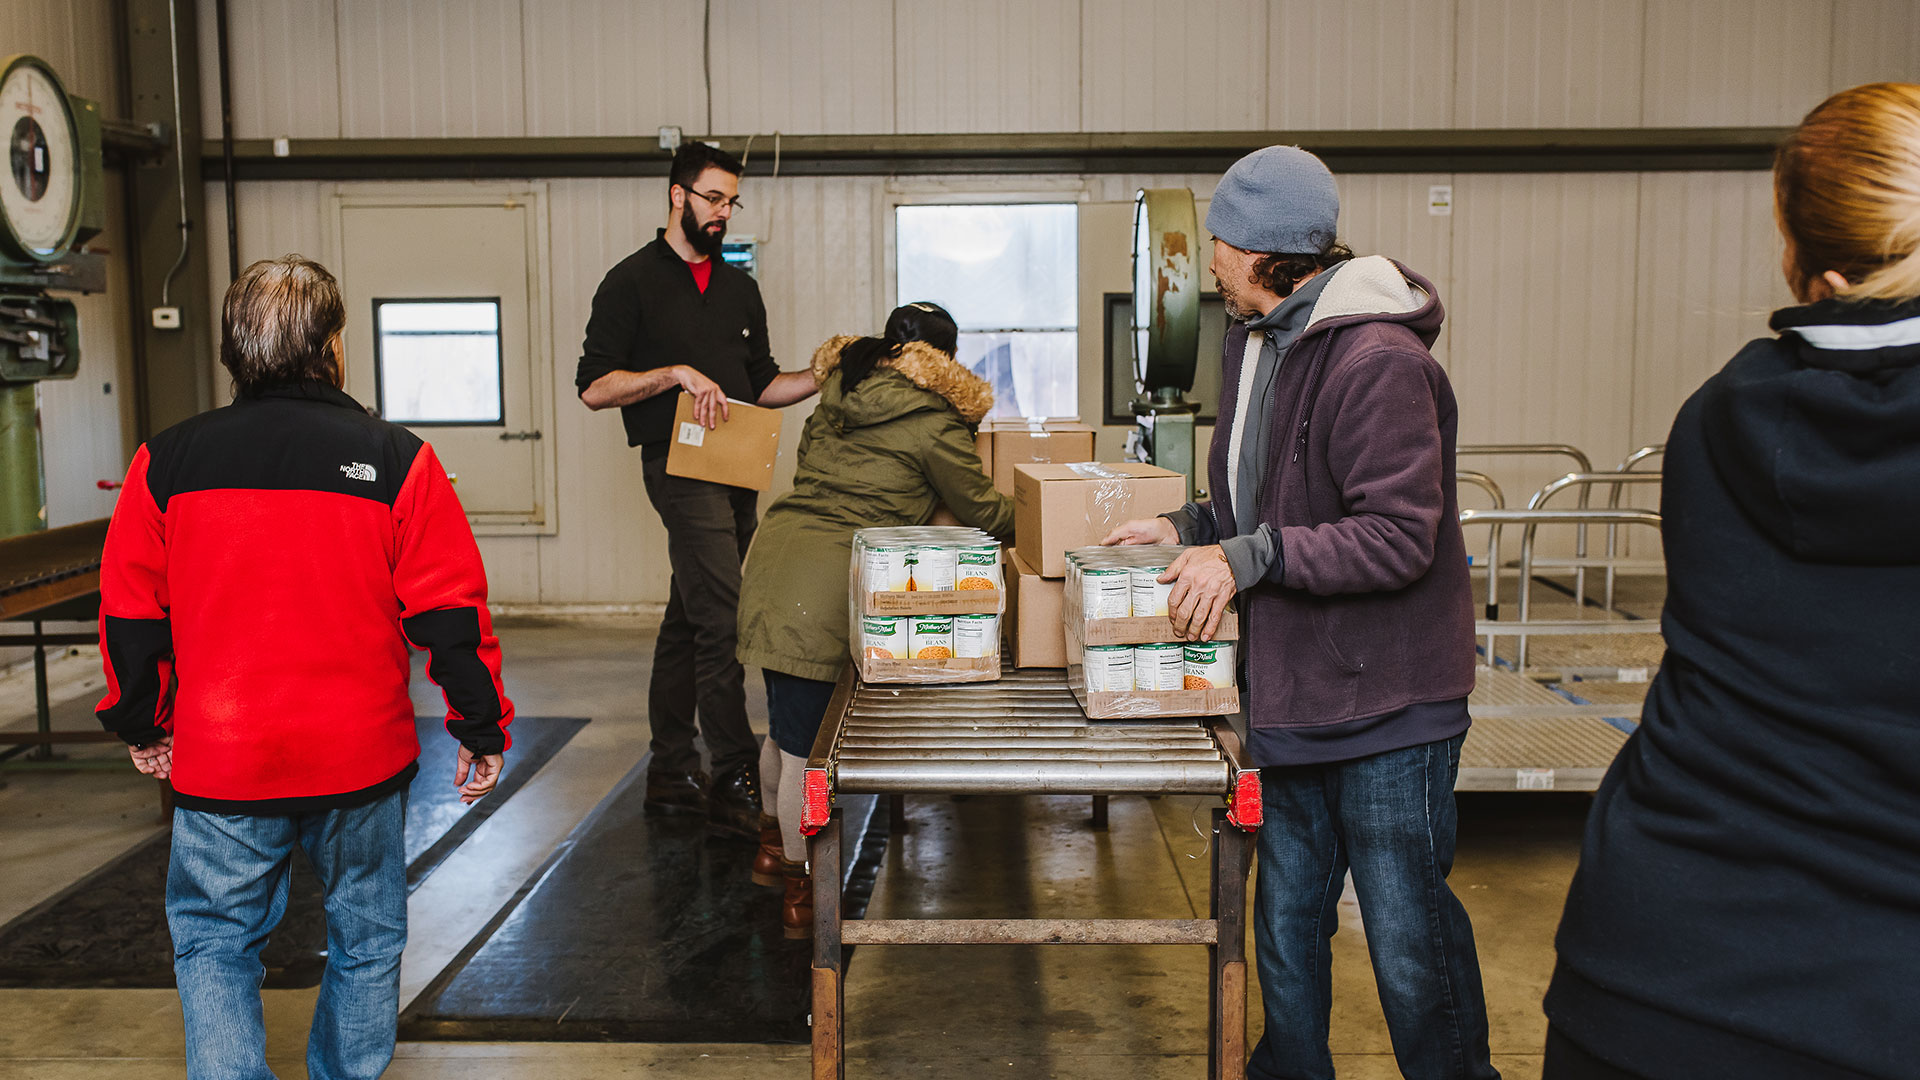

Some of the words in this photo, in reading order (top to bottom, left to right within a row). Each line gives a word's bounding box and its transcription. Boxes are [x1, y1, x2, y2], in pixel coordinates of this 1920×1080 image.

[340, 464, 364, 476] NORTH
[352, 461, 366, 470] THE
[346, 471, 364, 480] FACE
